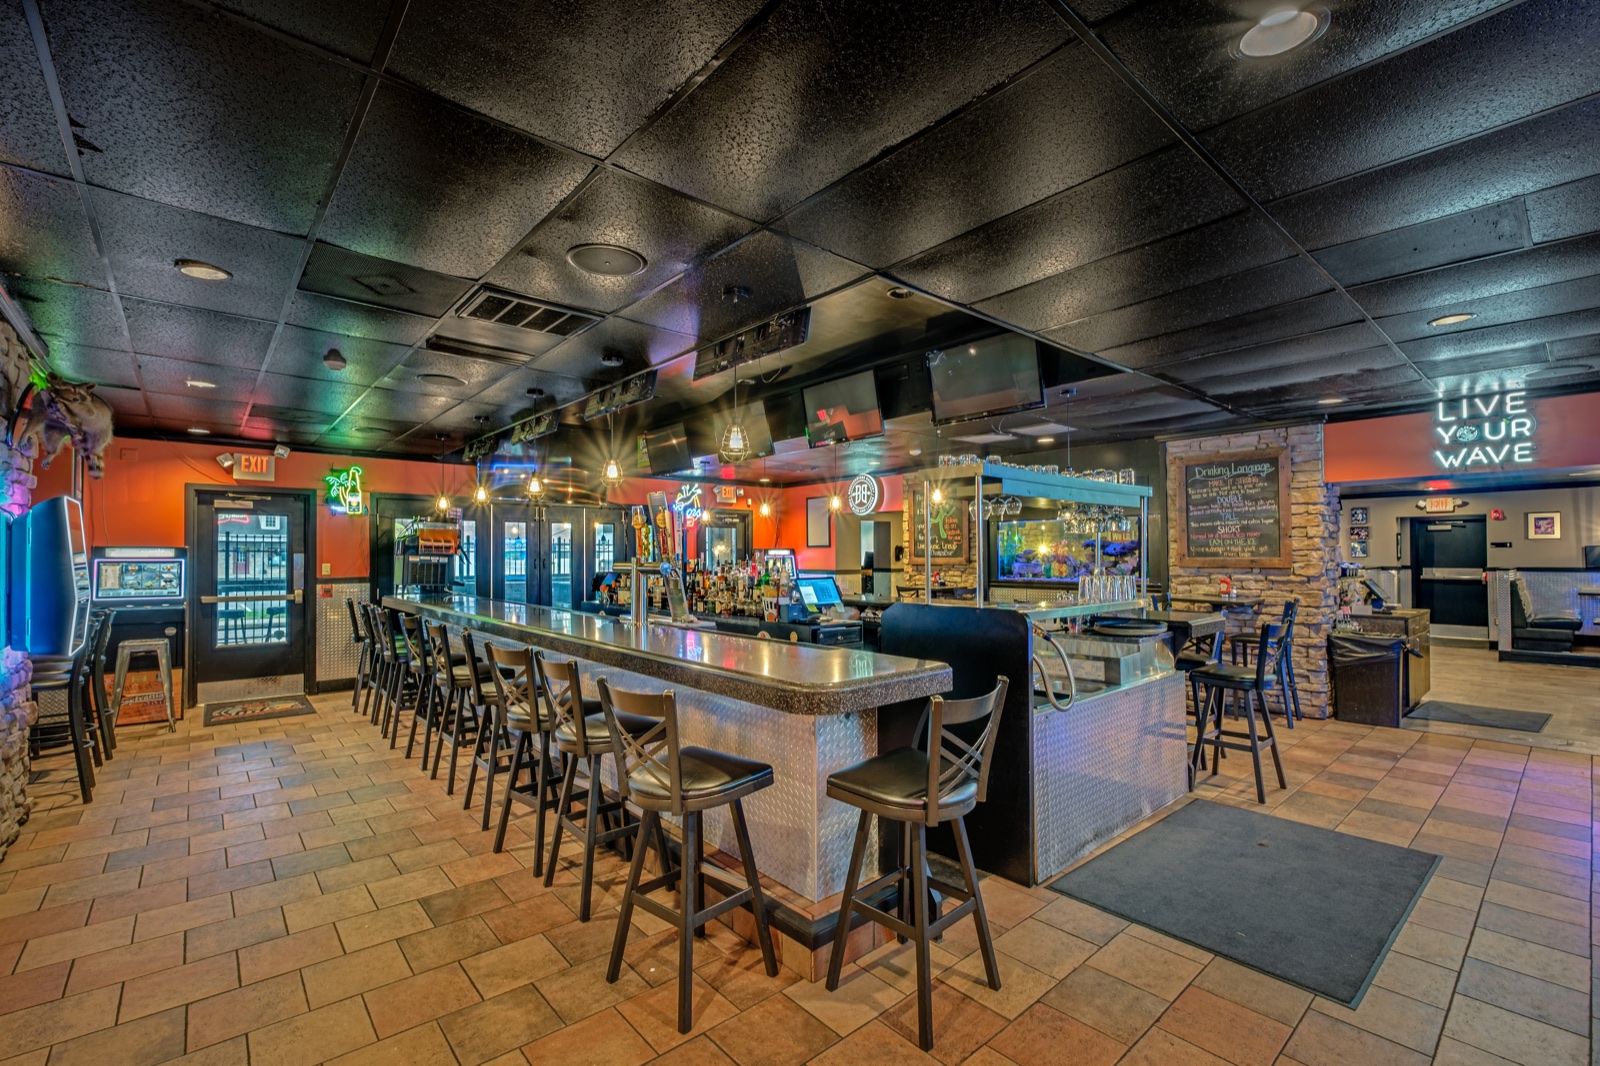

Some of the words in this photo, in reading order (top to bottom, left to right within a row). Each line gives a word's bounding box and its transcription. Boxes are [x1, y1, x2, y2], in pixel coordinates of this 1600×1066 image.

[1438, 391, 1526, 422] LIVE
[1435, 442, 1533, 468] WAVE
[241, 455, 269, 473] EXIT
[1195, 465, 1230, 479] Drinking
[1232, 463, 1271, 477] Language
[1227, 478, 1233, 486] IT
[722, 486, 734, 498] EXIT
[1217, 494, 1243, 504] DOUBLE
[1218, 525, 1241, 534] SHORT
